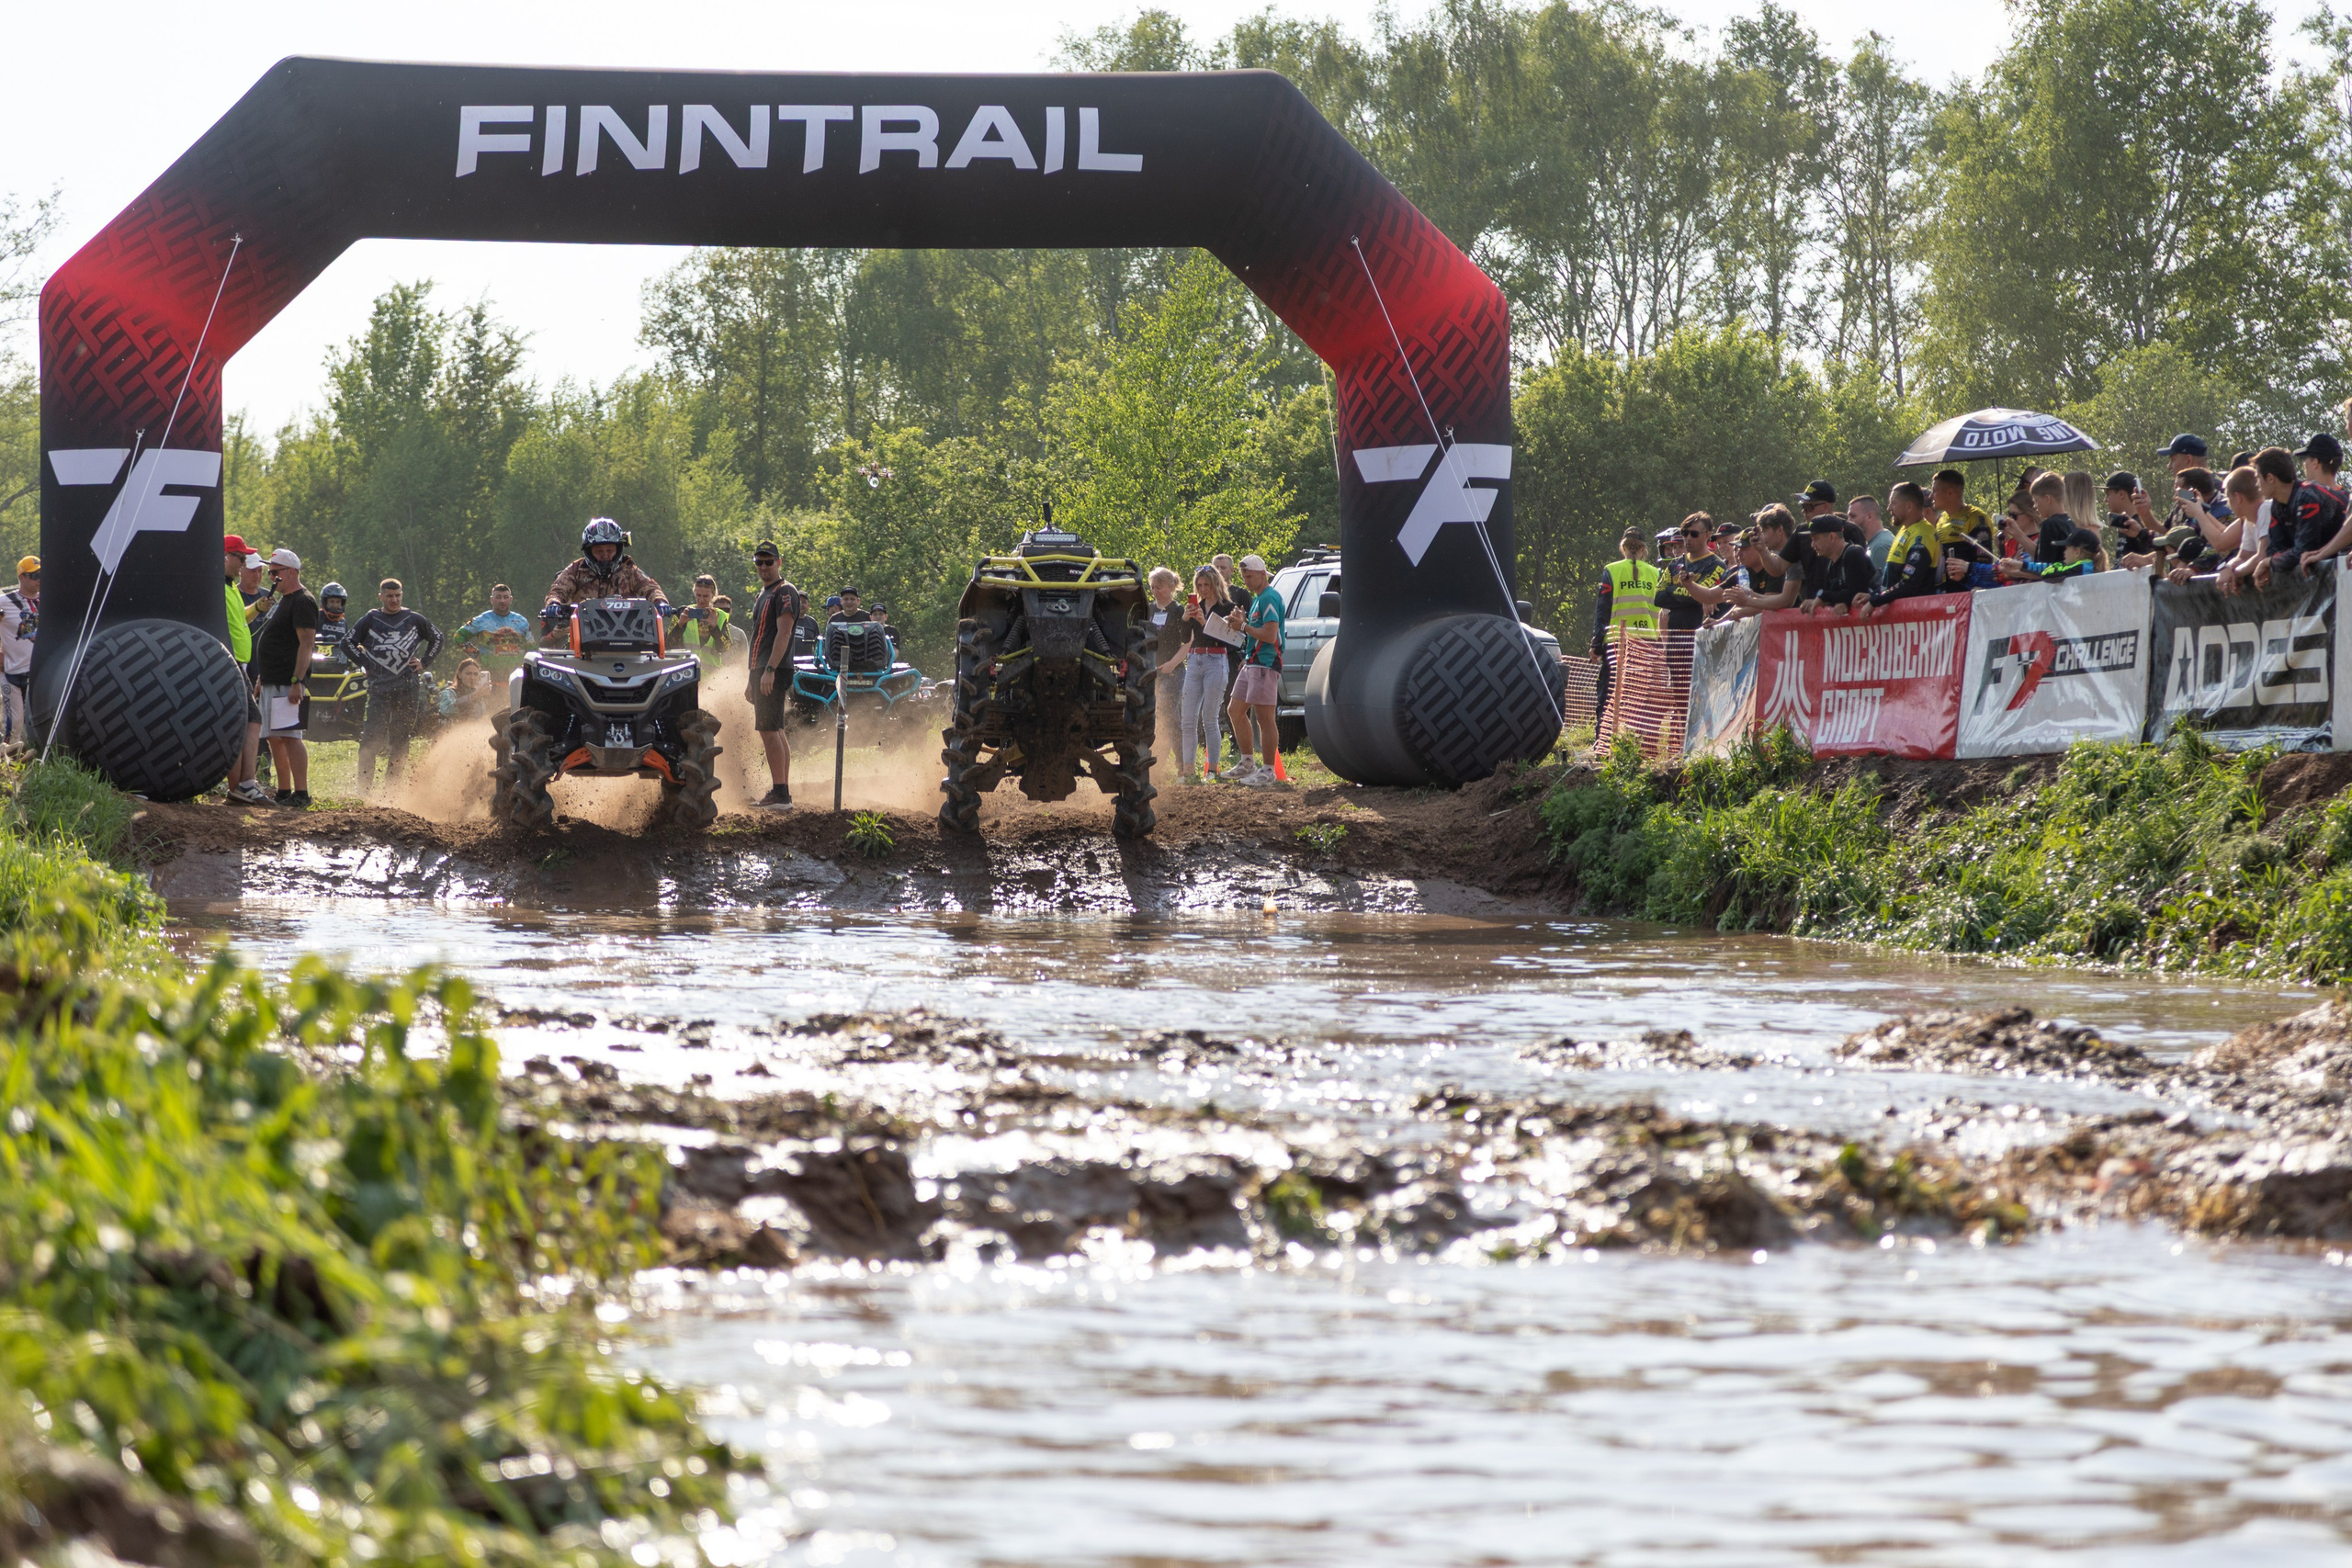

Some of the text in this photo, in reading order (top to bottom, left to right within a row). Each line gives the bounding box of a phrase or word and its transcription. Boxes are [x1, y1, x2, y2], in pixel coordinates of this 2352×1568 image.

[455, 104, 1144, 178] FINNTRAIL
[1964, 425, 2028, 447] MOTO
[1620, 581, 1653, 591] PRESS
[1633, 620, 1649, 629] 168
[1823, 605, 1957, 683] МОСКОВСКИЙ
[2054, 636, 2136, 671] CHALLENGE
[2163, 615, 2330, 712] AODES
[1815, 687, 1885, 745] СПОРТ
